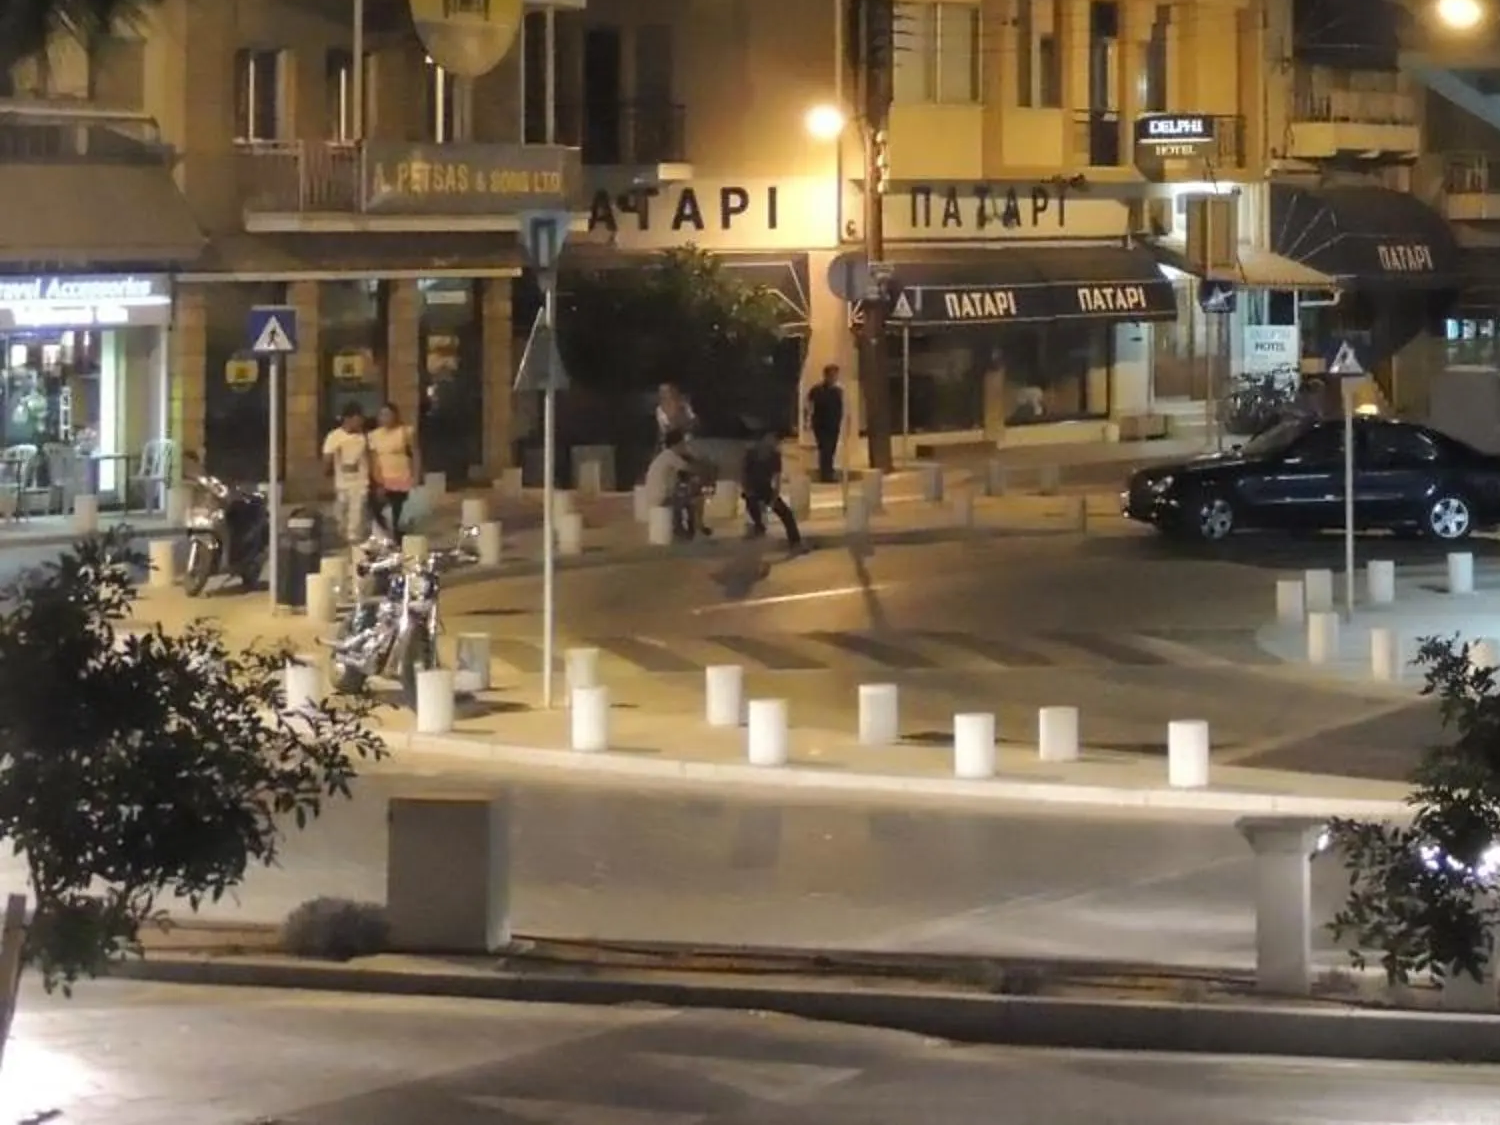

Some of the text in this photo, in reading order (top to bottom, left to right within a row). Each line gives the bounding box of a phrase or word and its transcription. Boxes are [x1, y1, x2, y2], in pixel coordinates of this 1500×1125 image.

[1149, 118, 1203, 134] DELPHI
[1155, 144, 1197, 156] HOTEL
[397, 161, 469, 193] PETSAS
[944, 285, 1147, 319] ΠΑΤΑΡΙ ΠΑΤΑΡΙ
